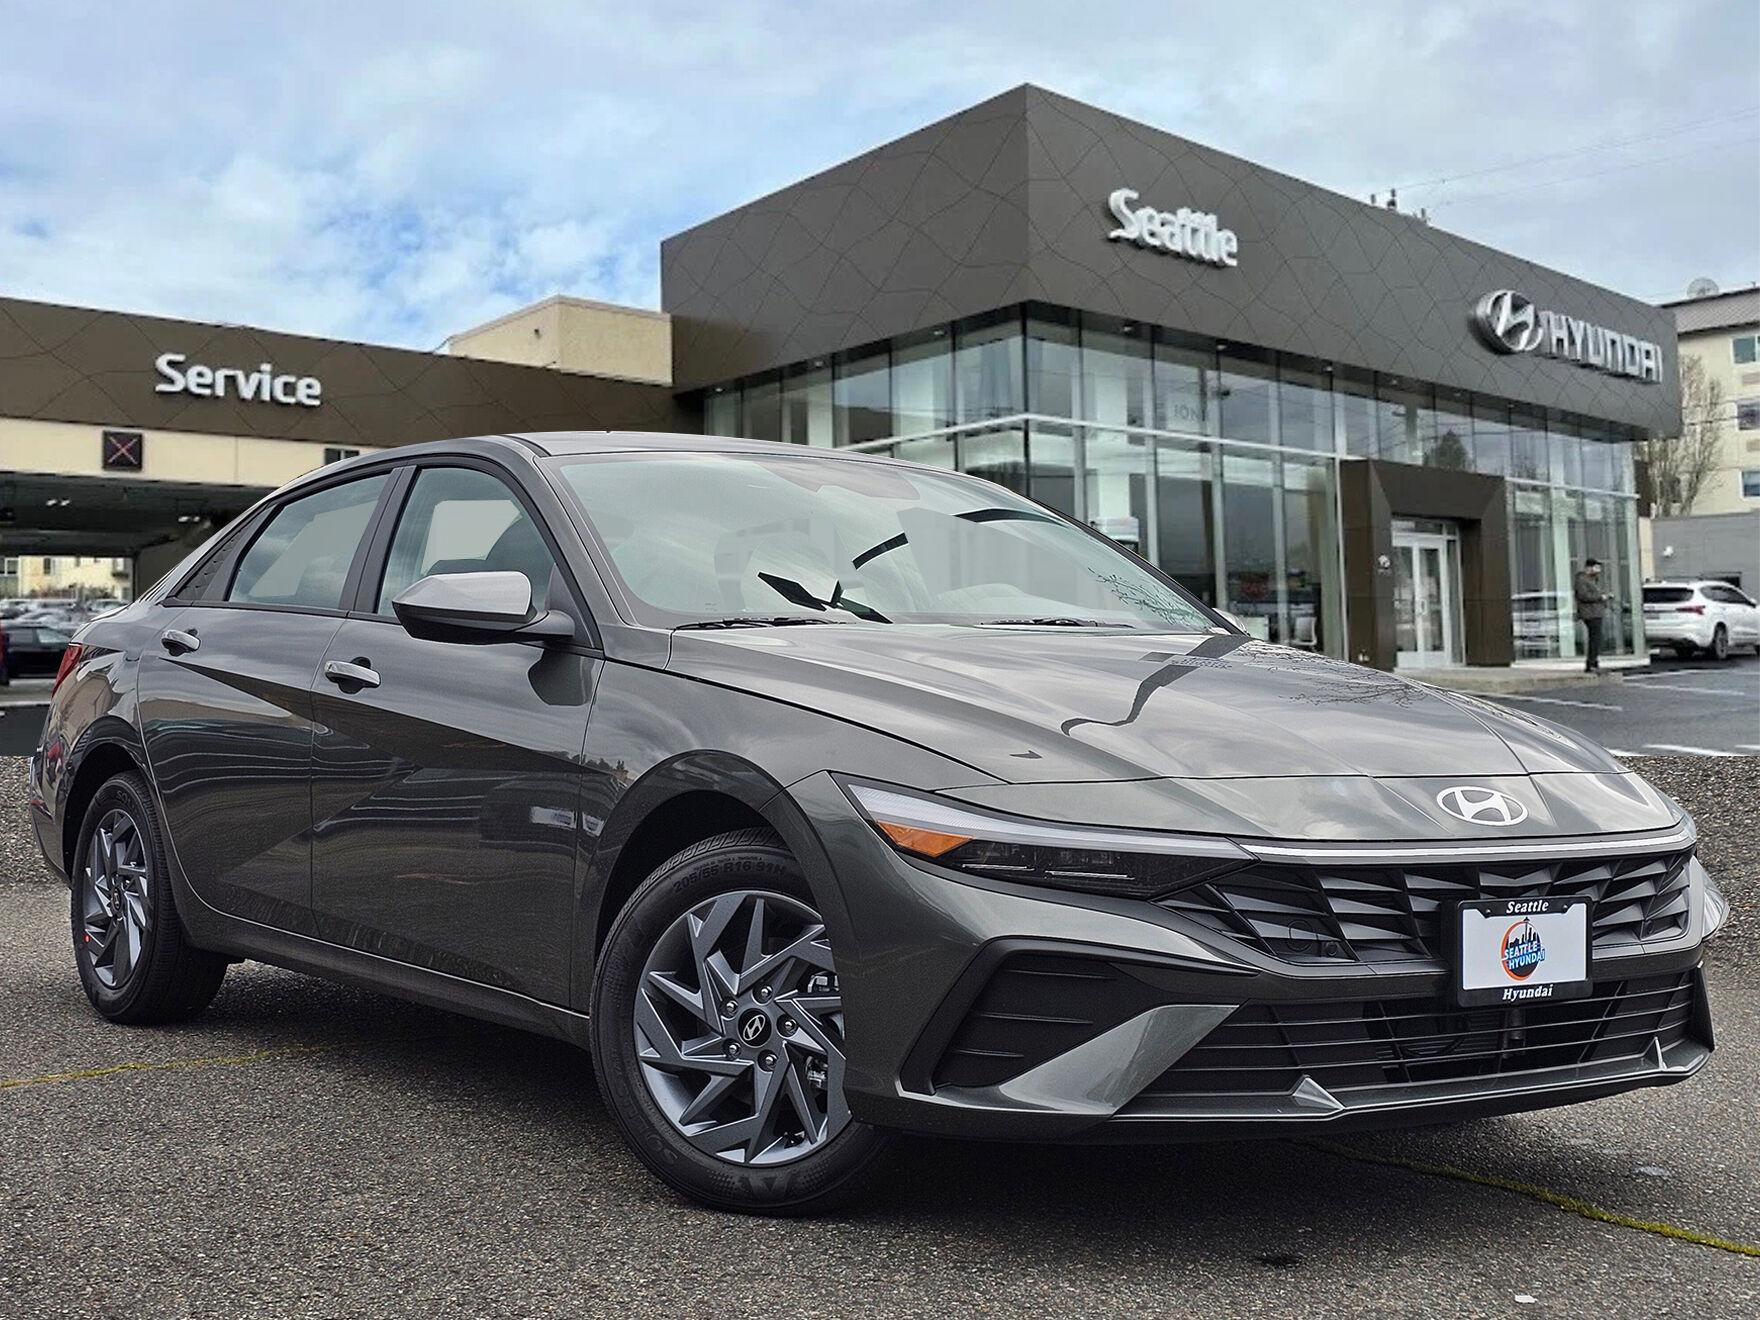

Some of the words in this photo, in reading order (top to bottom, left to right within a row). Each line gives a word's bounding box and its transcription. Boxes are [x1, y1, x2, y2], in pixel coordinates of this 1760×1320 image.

[1108, 188, 1238, 266] Seattle
[1540, 311, 1662, 382] HYUNDAI
[155, 353, 322, 406] Service
[1506, 900, 1549, 913] Seattle
[1504, 941, 1538, 960] SEATTLE
[1508, 948, 1545, 969] HYUNDAI
[1502, 984, 1553, 1001] Hyundai
